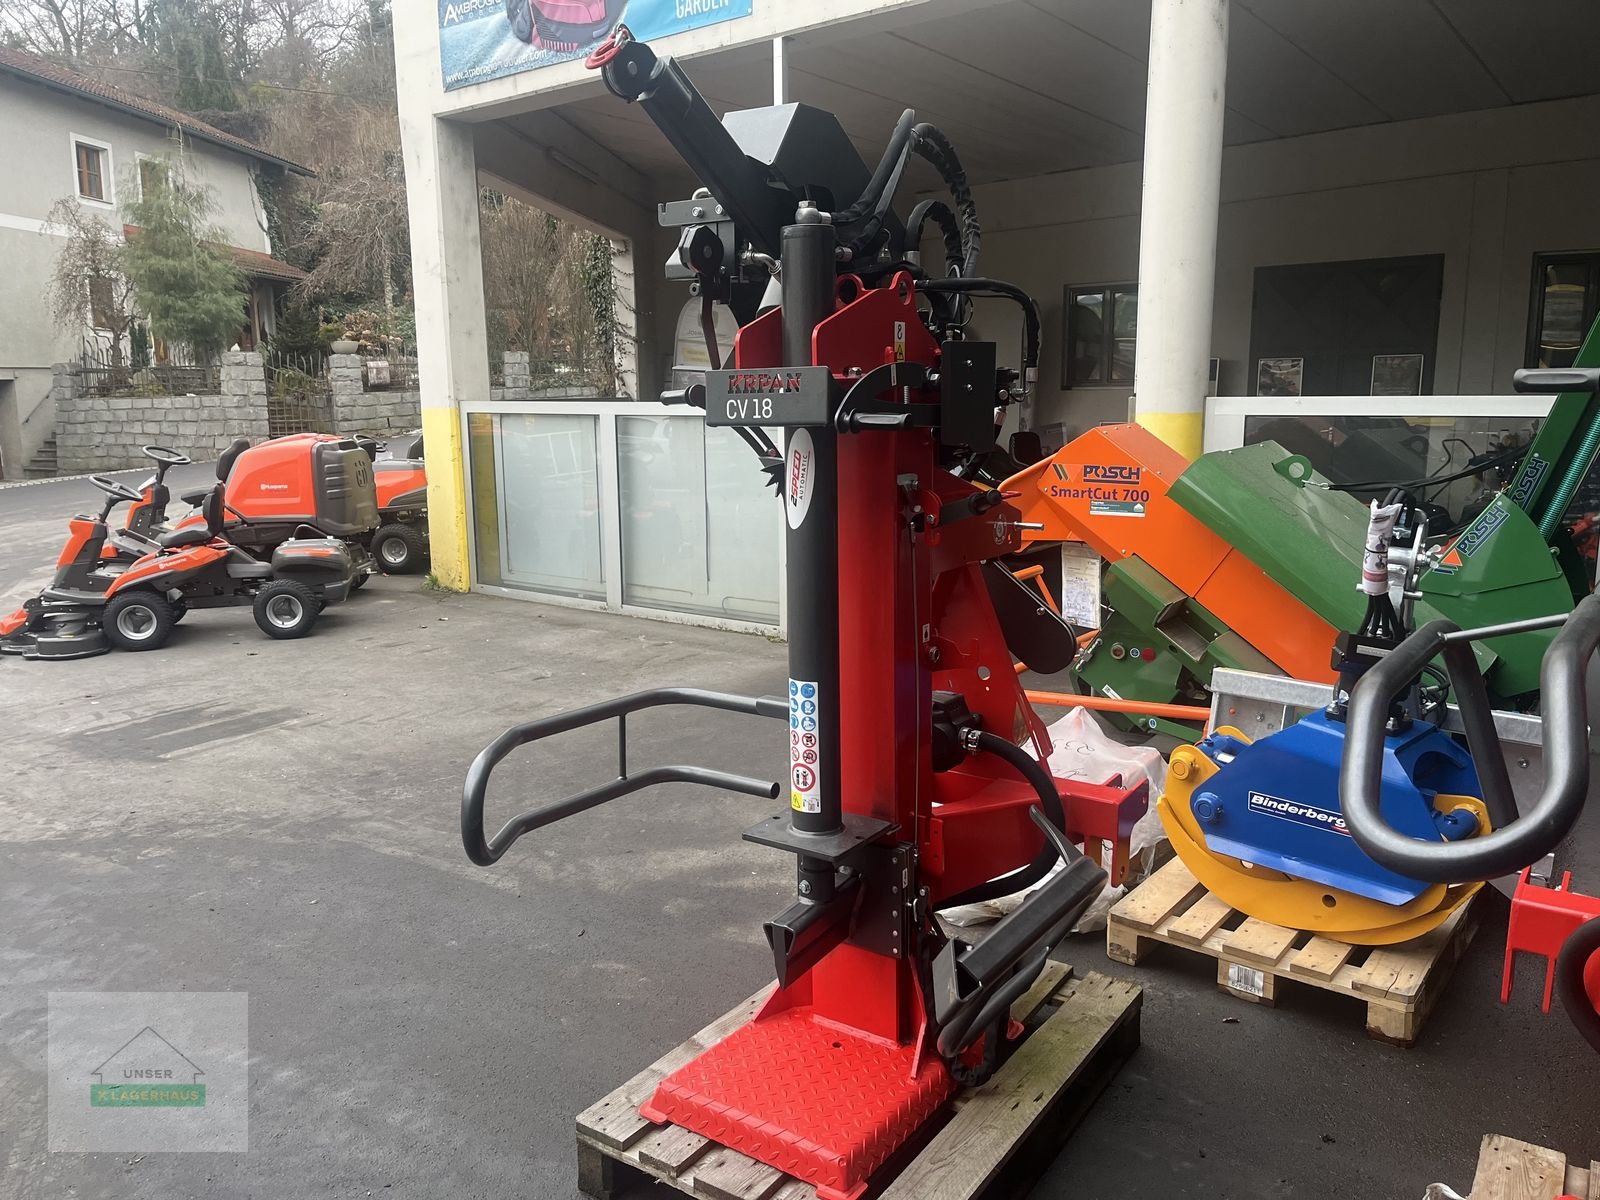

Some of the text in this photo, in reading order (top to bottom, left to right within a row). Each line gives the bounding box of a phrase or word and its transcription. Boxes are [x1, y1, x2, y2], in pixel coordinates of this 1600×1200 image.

[444, 0, 504, 26] AMBROGI
[676, 0, 729, 18] GARD
[727, 372, 802, 395] KRPAN
[726, 398, 773, 420] CV 18
[799, 454, 808, 500] AUTOMATIC
[1083, 464, 1140, 480] POSCH
[1511, 459, 1544, 504] OSCH
[1050, 485, 1150, 503] SmartCut 700
[1456, 504, 1506, 554] POSCH
[1251, 794, 1346, 828] Binderberg
